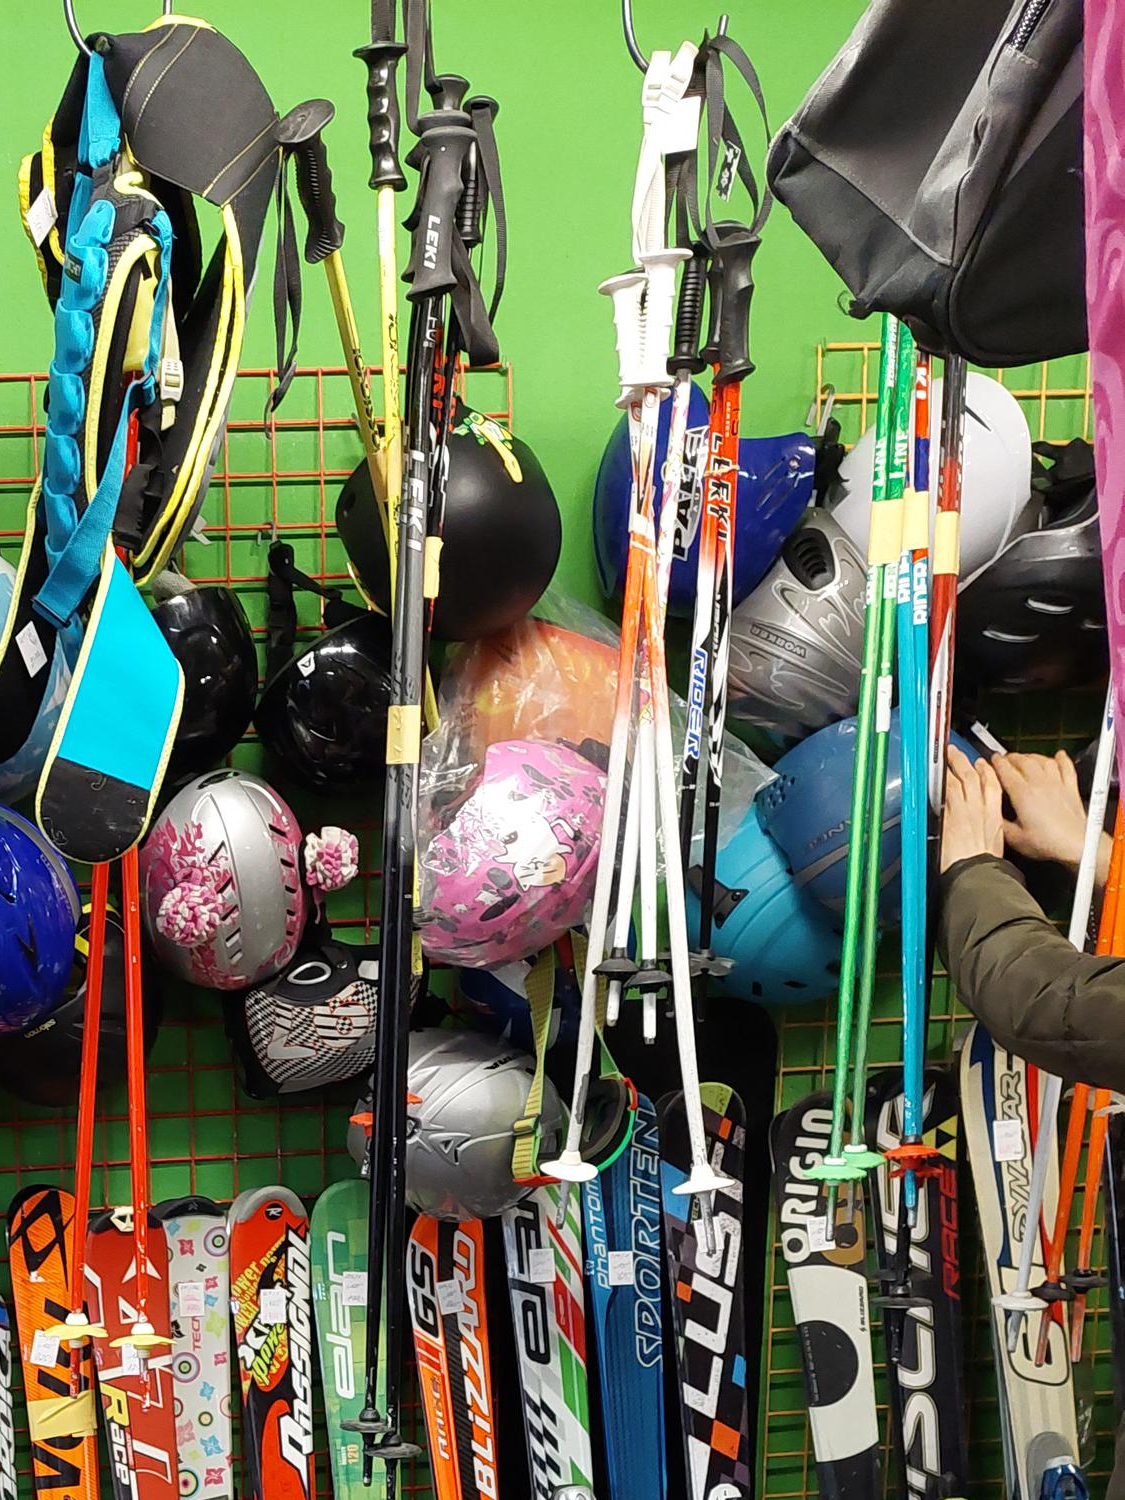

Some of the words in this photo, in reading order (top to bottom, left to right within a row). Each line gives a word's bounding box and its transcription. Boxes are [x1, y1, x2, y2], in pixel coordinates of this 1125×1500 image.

[423, 214, 442, 270] LEKI
[685, 646, 708, 760] RIDER
[751, 626, 806, 656] WORKER
[781, 1109, 833, 1264] ORIGIN
[1001, 1071, 1031, 1244] DYNAAR
[410, 1248, 440, 1341] GS
[629, 1108, 663, 1369] SPORTEN
[937, 1164, 961, 1300] RACE
[326, 1231, 356, 1400] elan
[99, 1382, 131, 1487] Race
